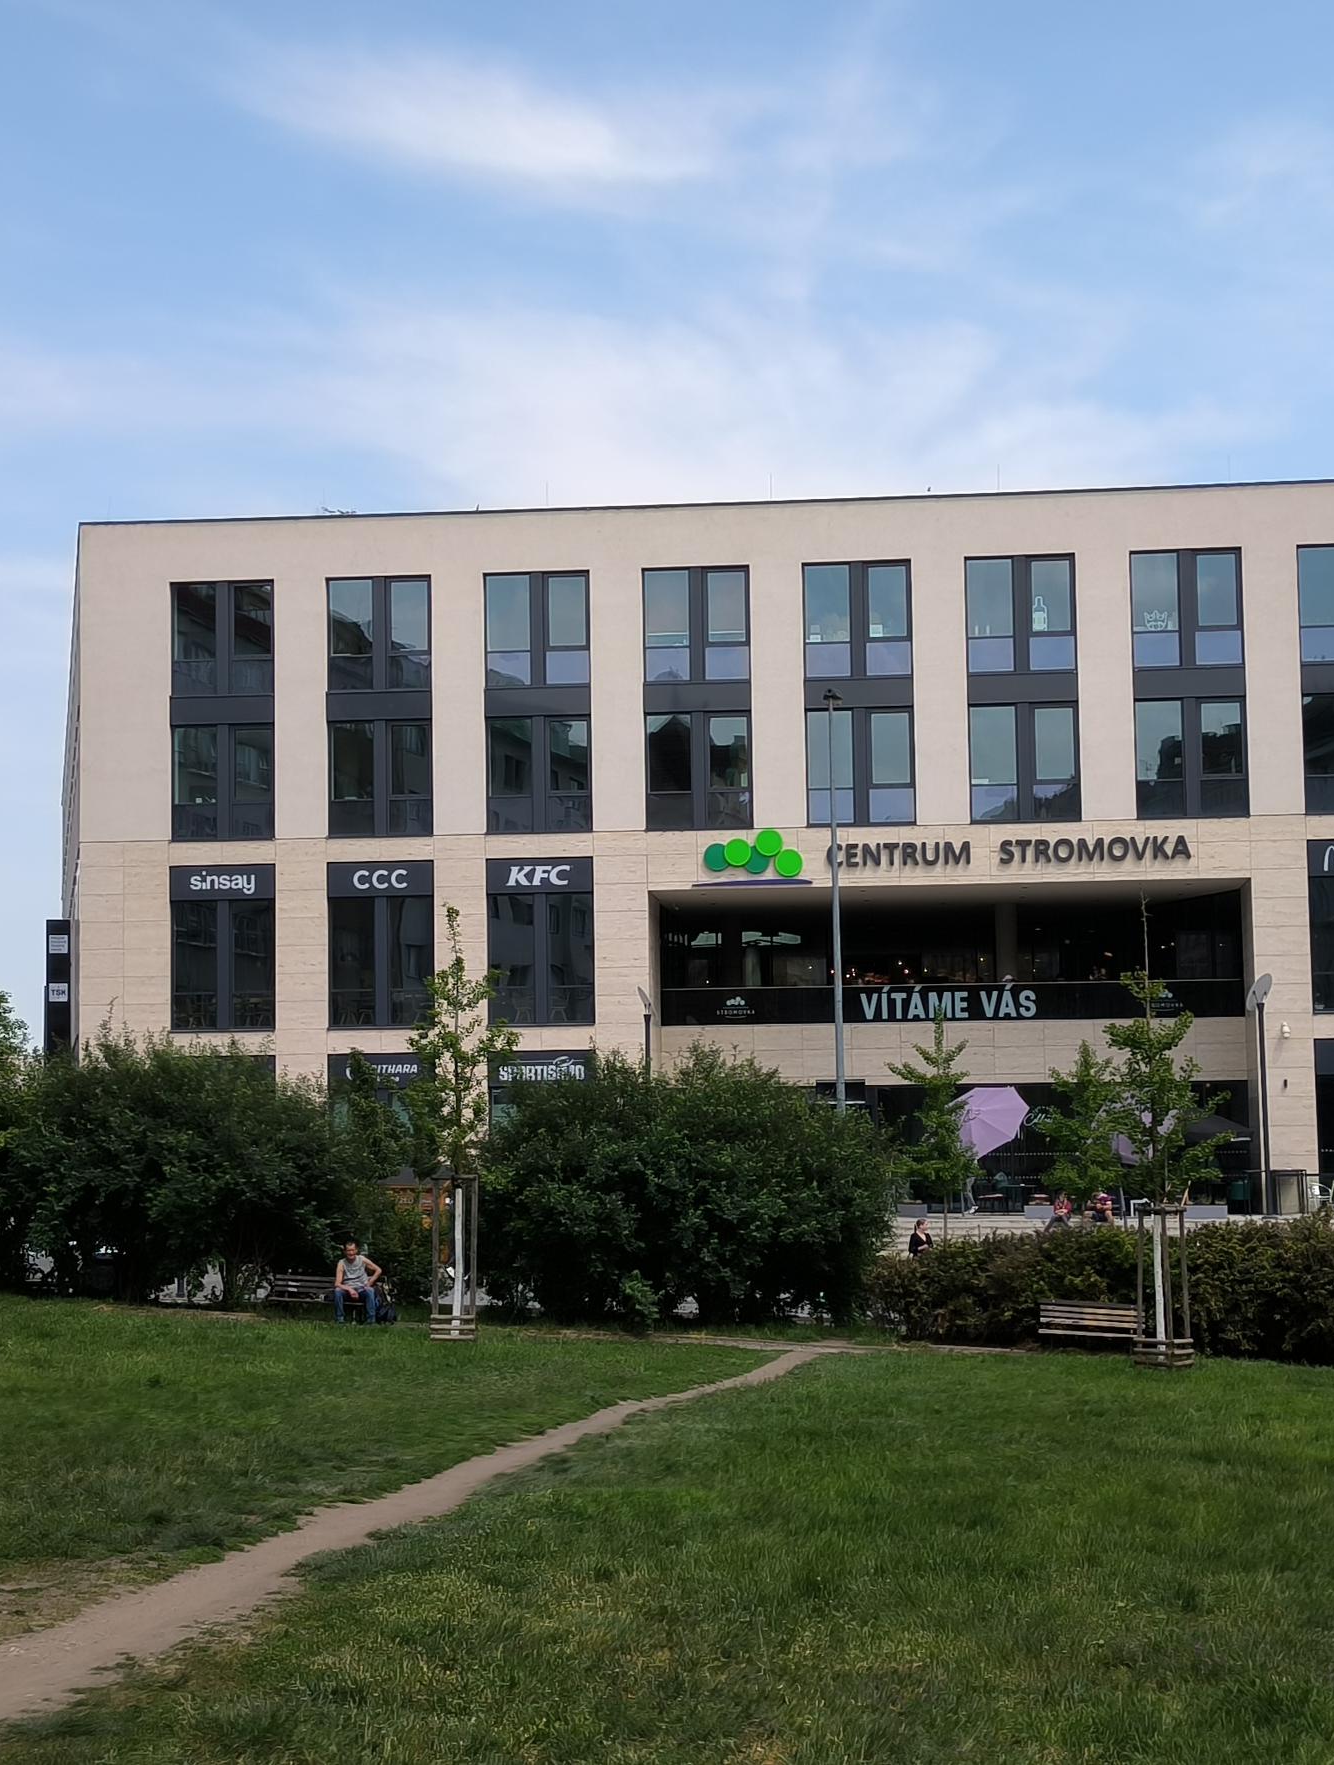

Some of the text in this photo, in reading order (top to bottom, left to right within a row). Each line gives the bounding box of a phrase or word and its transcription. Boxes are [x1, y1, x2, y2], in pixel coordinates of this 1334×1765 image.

[826, 835, 1192, 868] CENTRUM STROMOVKA
[190, 870, 256, 895] sinsay
[352, 869, 409, 889] CCC
[505, 865, 570, 887] KFC
[860, 983, 1038, 1020] VÍTÁME VÁS
[371, 1063, 418, 1074] ITHARA
